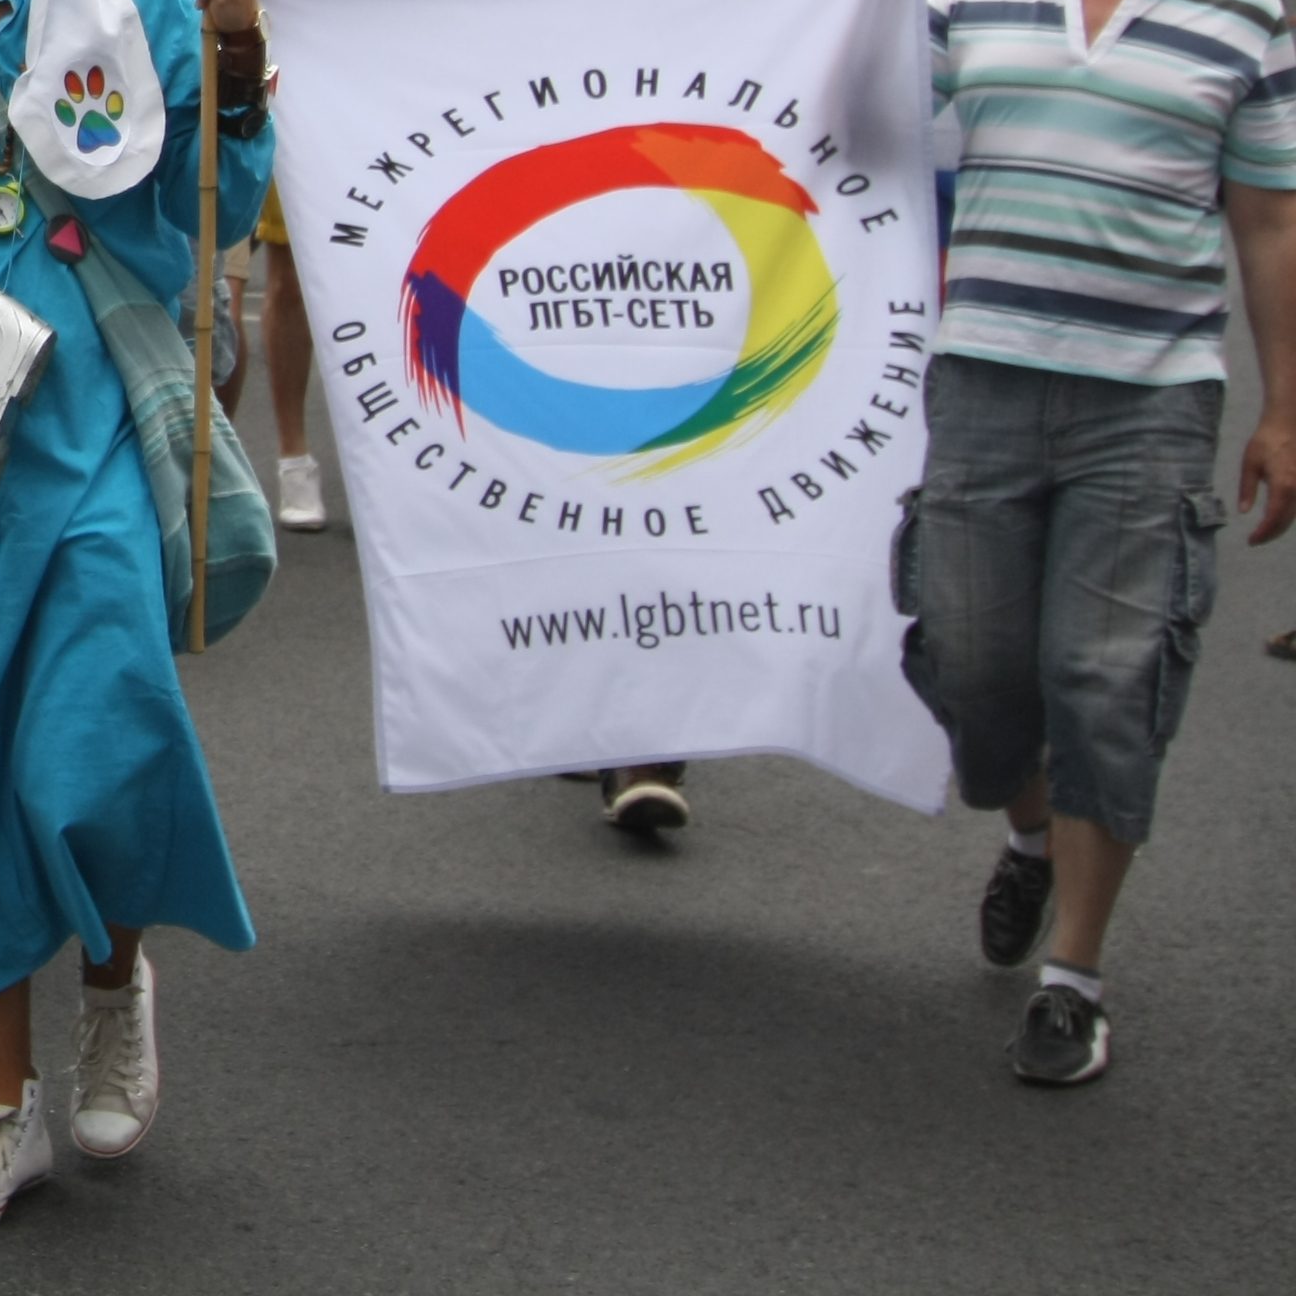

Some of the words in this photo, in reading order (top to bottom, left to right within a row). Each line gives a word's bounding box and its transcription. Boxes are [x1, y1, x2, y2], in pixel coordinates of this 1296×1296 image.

[330, 67, 898, 247] МЕЖРЕГИОНАЛЬНОЕ
[499, 253, 733, 297] РОССИЙСКАЯ
[528, 298, 715, 331] ЛГБТ-СЕТЬ
[331, 320, 709, 538] ОБЩЕСТВЕННОЕ
[758, 297, 927, 526] ДВИЖЕНИЕ
[500, 590, 842, 650] www.lgbtnet.ru
